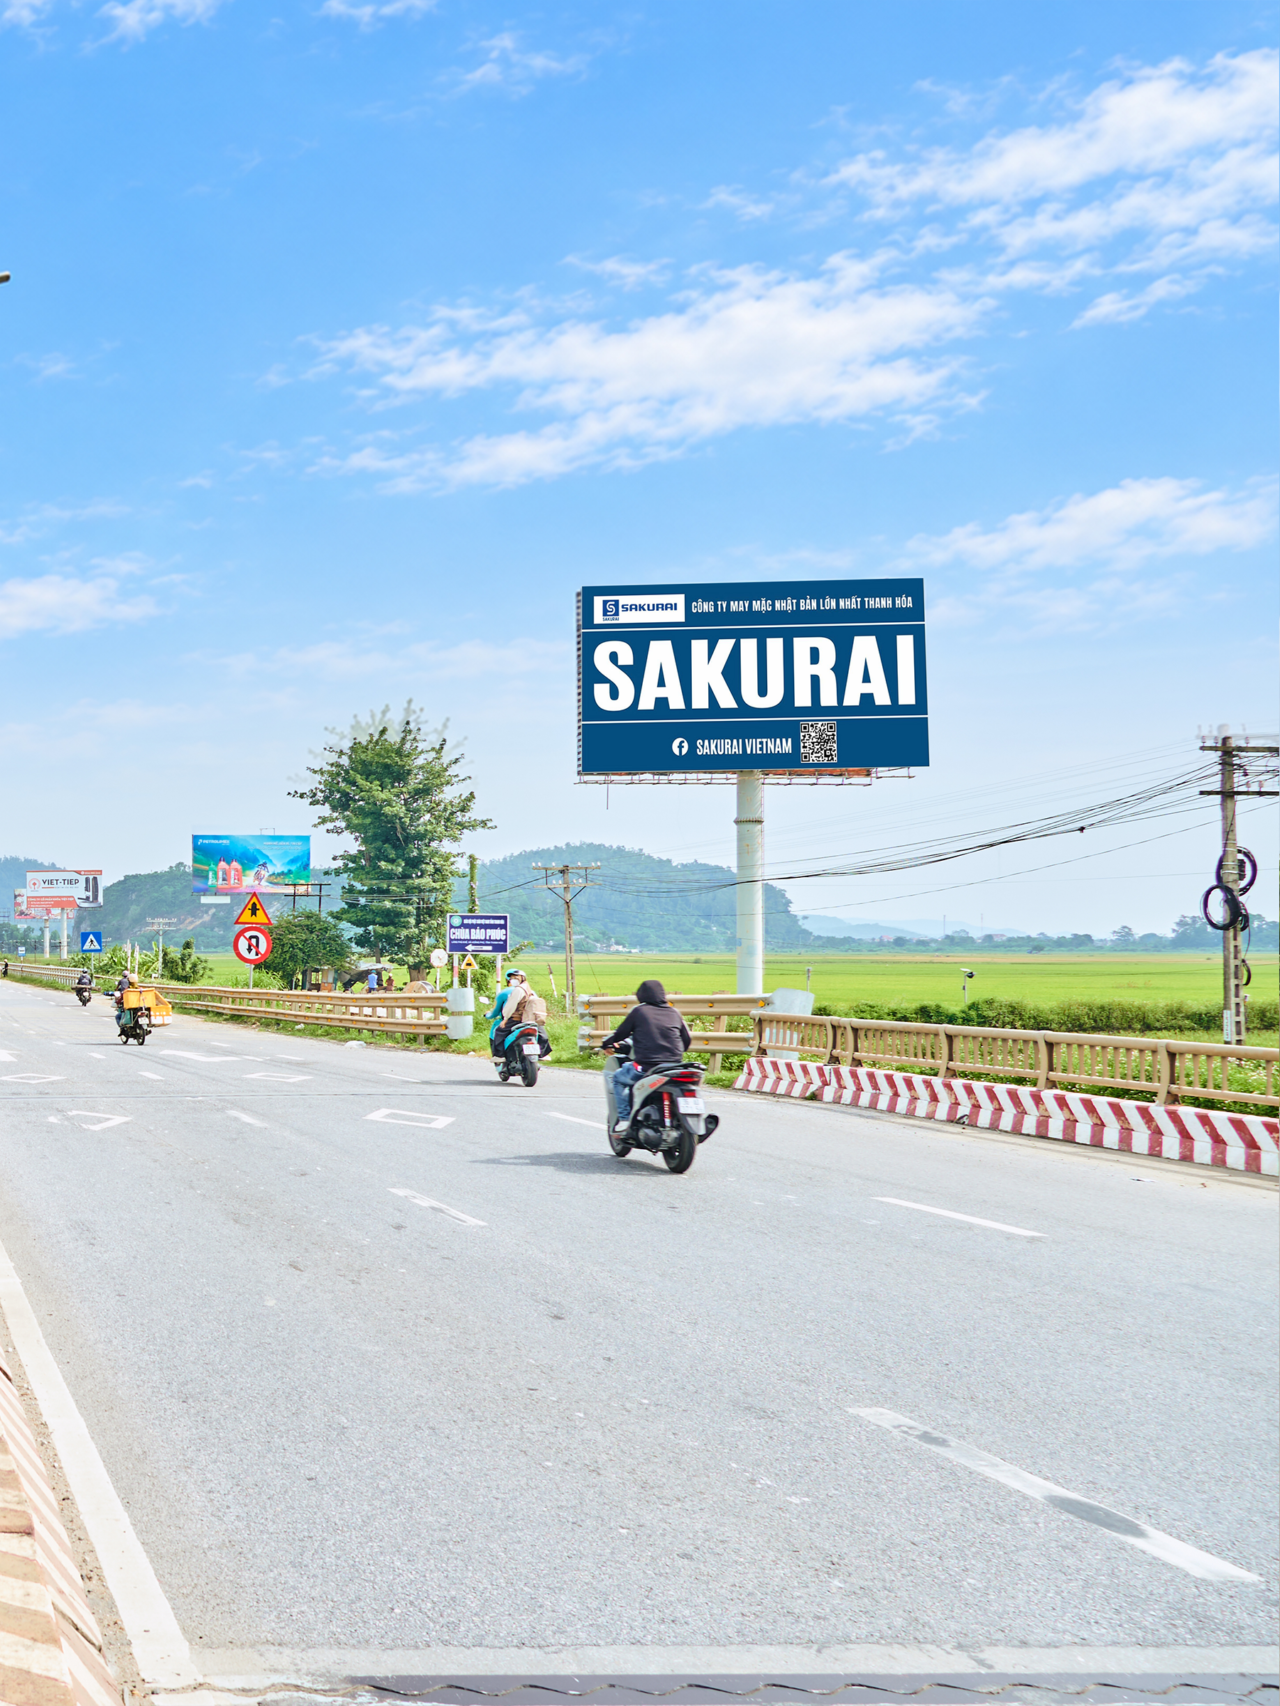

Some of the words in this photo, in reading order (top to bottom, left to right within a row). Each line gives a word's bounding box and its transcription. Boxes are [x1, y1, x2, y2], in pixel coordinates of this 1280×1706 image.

[621, 603, 677, 612] SAKURAI
[692, 599, 714, 613] CÔNG
[717, 601, 727, 612] TY
[730, 601, 749, 612] MAY
[752, 598, 772, 613] MẶC
[775, 597, 797, 613] NHẬT
[800, 596, 817, 611] BẢN
[820, 596, 837, 610] LỚN
[839, 595, 861, 610] NHẤT
[864, 597, 892, 609] THANH
[895, 594, 913, 608] HÓA
[593, 635, 916, 711] SAKURAI
[696, 739, 742, 755] SAKURAI
[745, 738, 792, 754] VIETNAM
